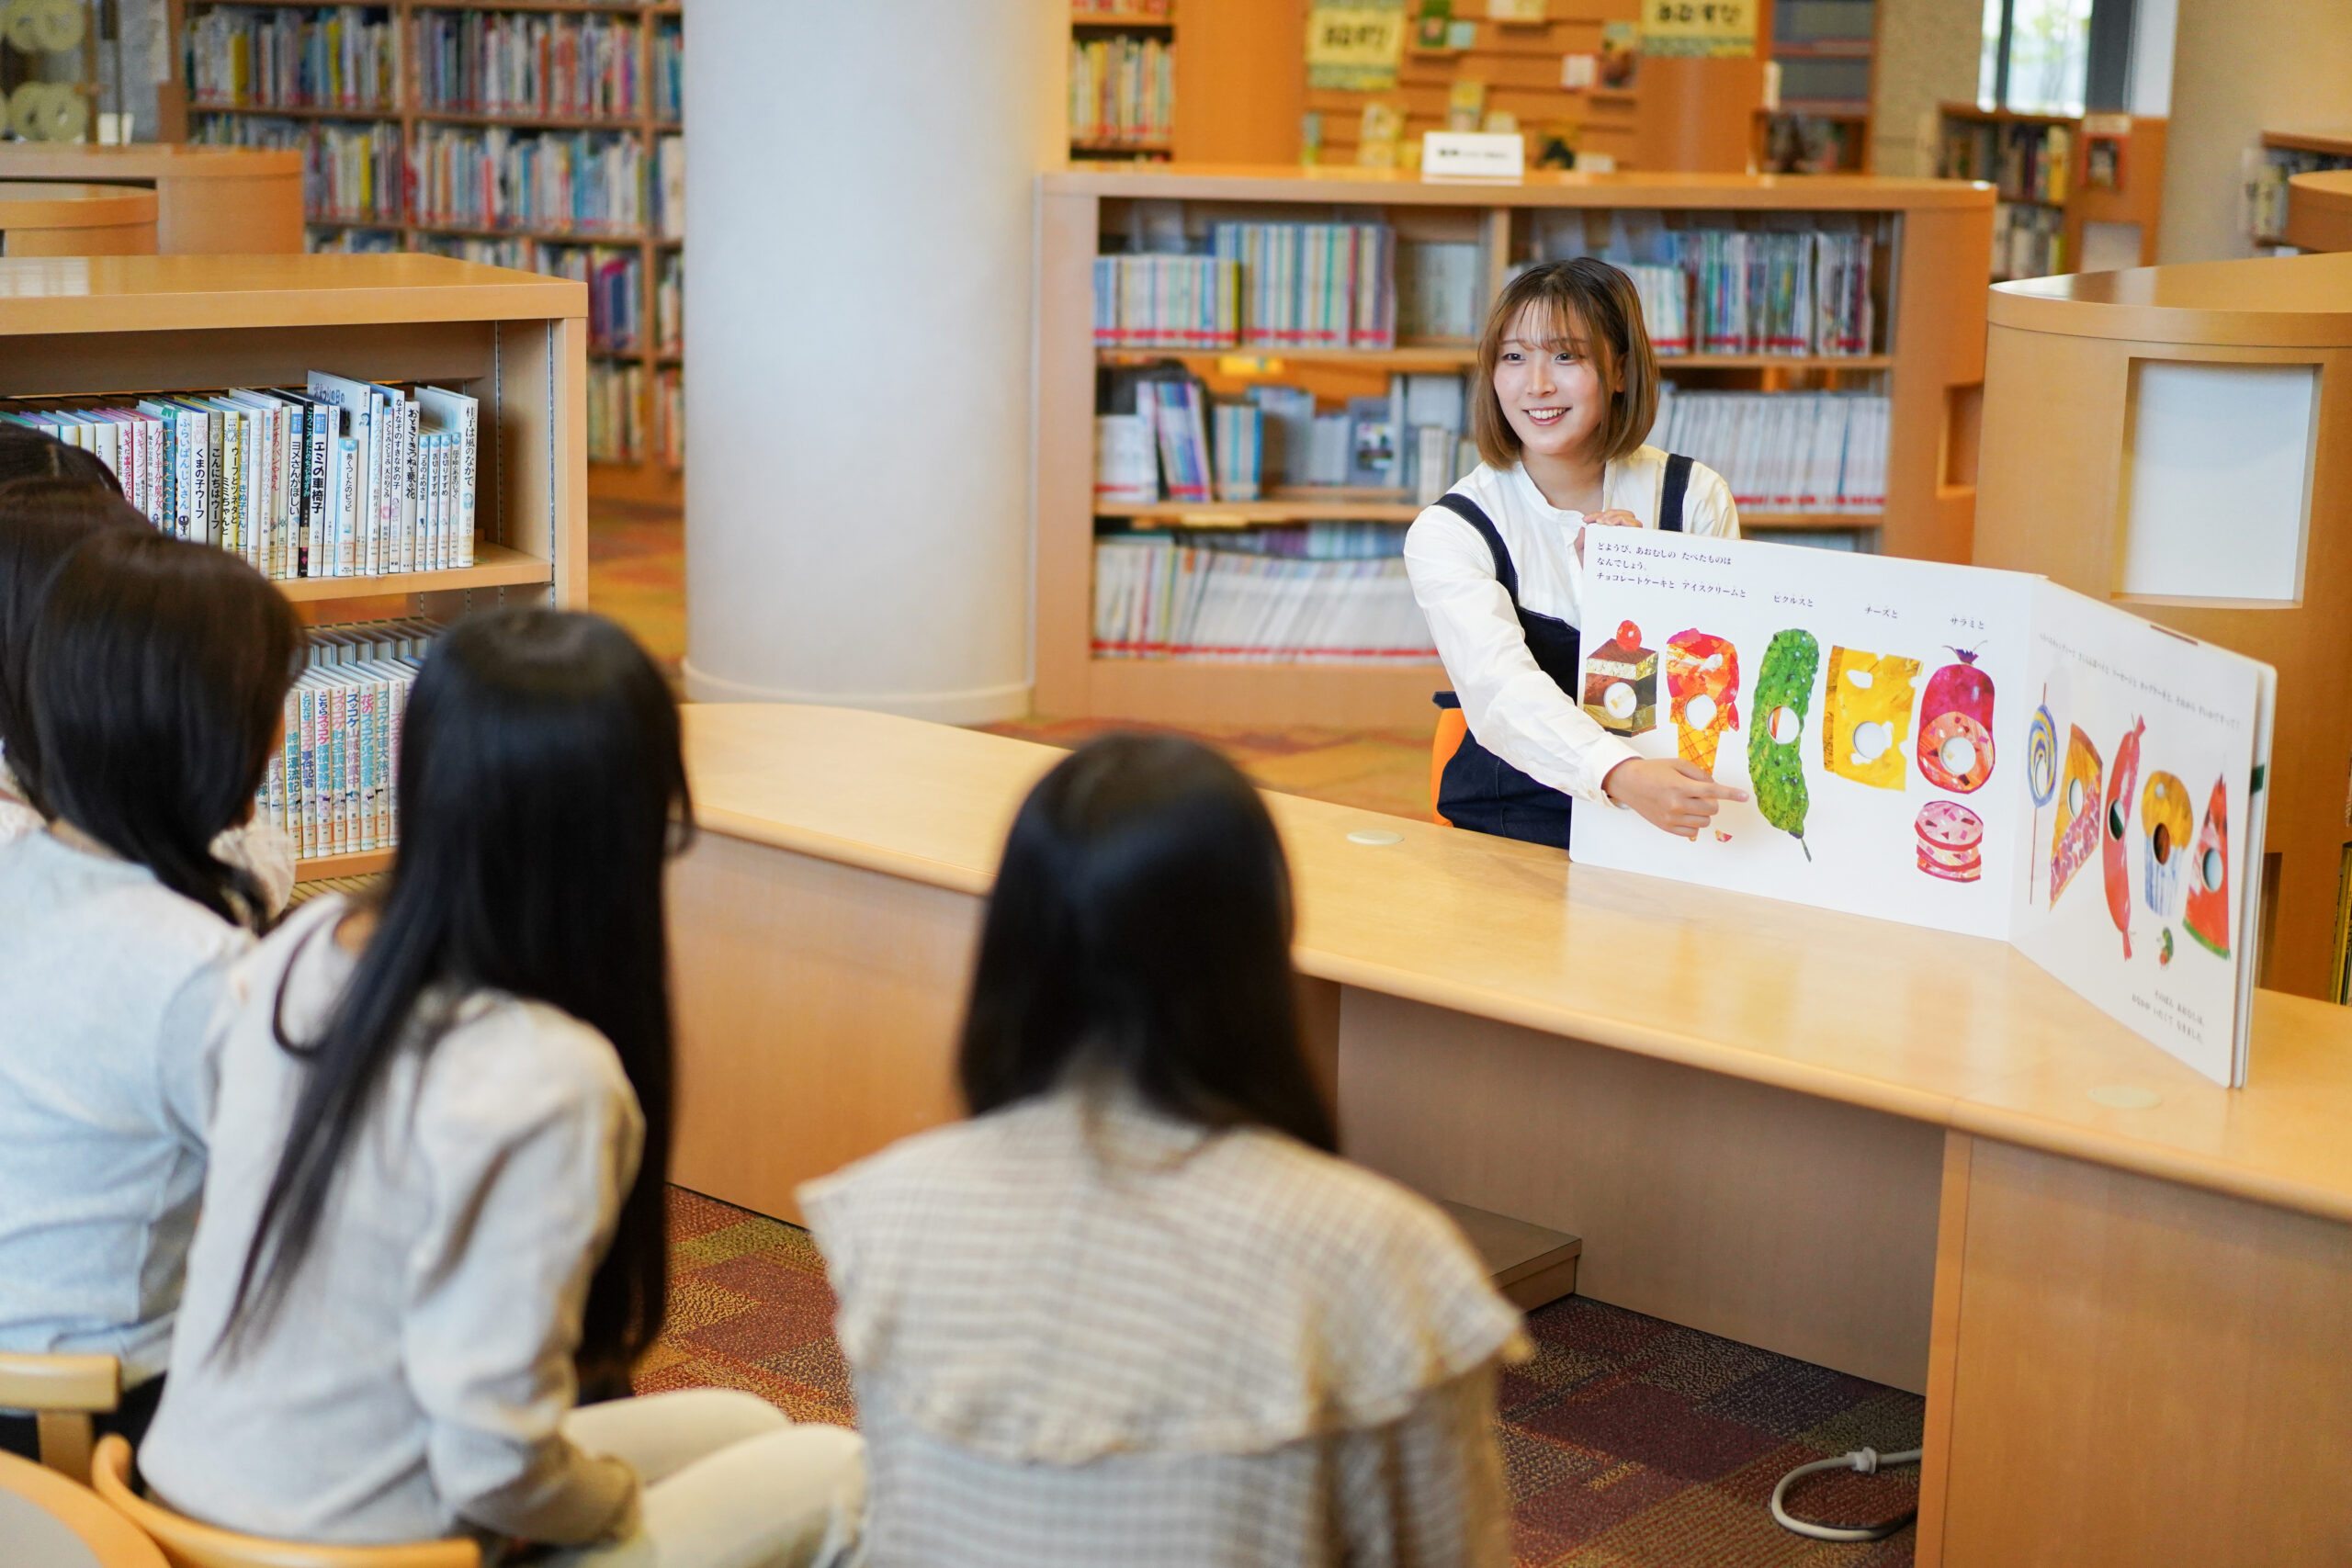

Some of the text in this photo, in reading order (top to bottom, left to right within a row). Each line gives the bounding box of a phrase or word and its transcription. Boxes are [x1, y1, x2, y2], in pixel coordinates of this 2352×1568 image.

[136, 428, 145, 479] キキとジジ
[153, 427, 164, 510] ケケと半分魔女
[179, 418, 190, 510] ふらいぱんじいさん
[289, 441, 301, 515] ヨメさんがほしい
[311, 442, 325, 514] エミの車椅子
[384, 420, 392, 465] くしゃみくしゃみ
[392, 399, 402, 490] なぞなぞのすきな女の子
[419, 454, 428, 501] つるのよめさま
[441, 453, 449, 497] 舌切りすずめ
[464, 407, 477, 487] 桂子は風のなかで
[195, 448, 206, 519] くまの子ウーフ
[210, 448, 221, 529] こんにちはウーフ
[222, 477, 231, 536] ミミちゃんと
[231, 447, 239, 525] ウーフとツネタと
[345, 453, 355, 513] 長くつしたのピッピ
[1597, 542, 1732, 565] どようび、 あおむしの たべたものは
[1597, 557, 1646, 571] なんでしょう。
[1597, 572, 1747, 598] チョコレートケーキと アイスクリームと
[1773, 593, 1814, 608] ピクルスと
[1864, 605, 1898, 619] チーズと
[1950, 616, 1984, 630] サラミと
[301, 694, 315, 789] とびだせズッコケ事件記者
[317, 694, 331, 792] こちらズッコケ探偵事務所
[332, 693, 346, 792] ズッコケ財宝調査隊
[361, 693, 375, 787] 花のズッコケ児童会長
[377, 691, 389, 784] ズッコケ宇宙大旅行
